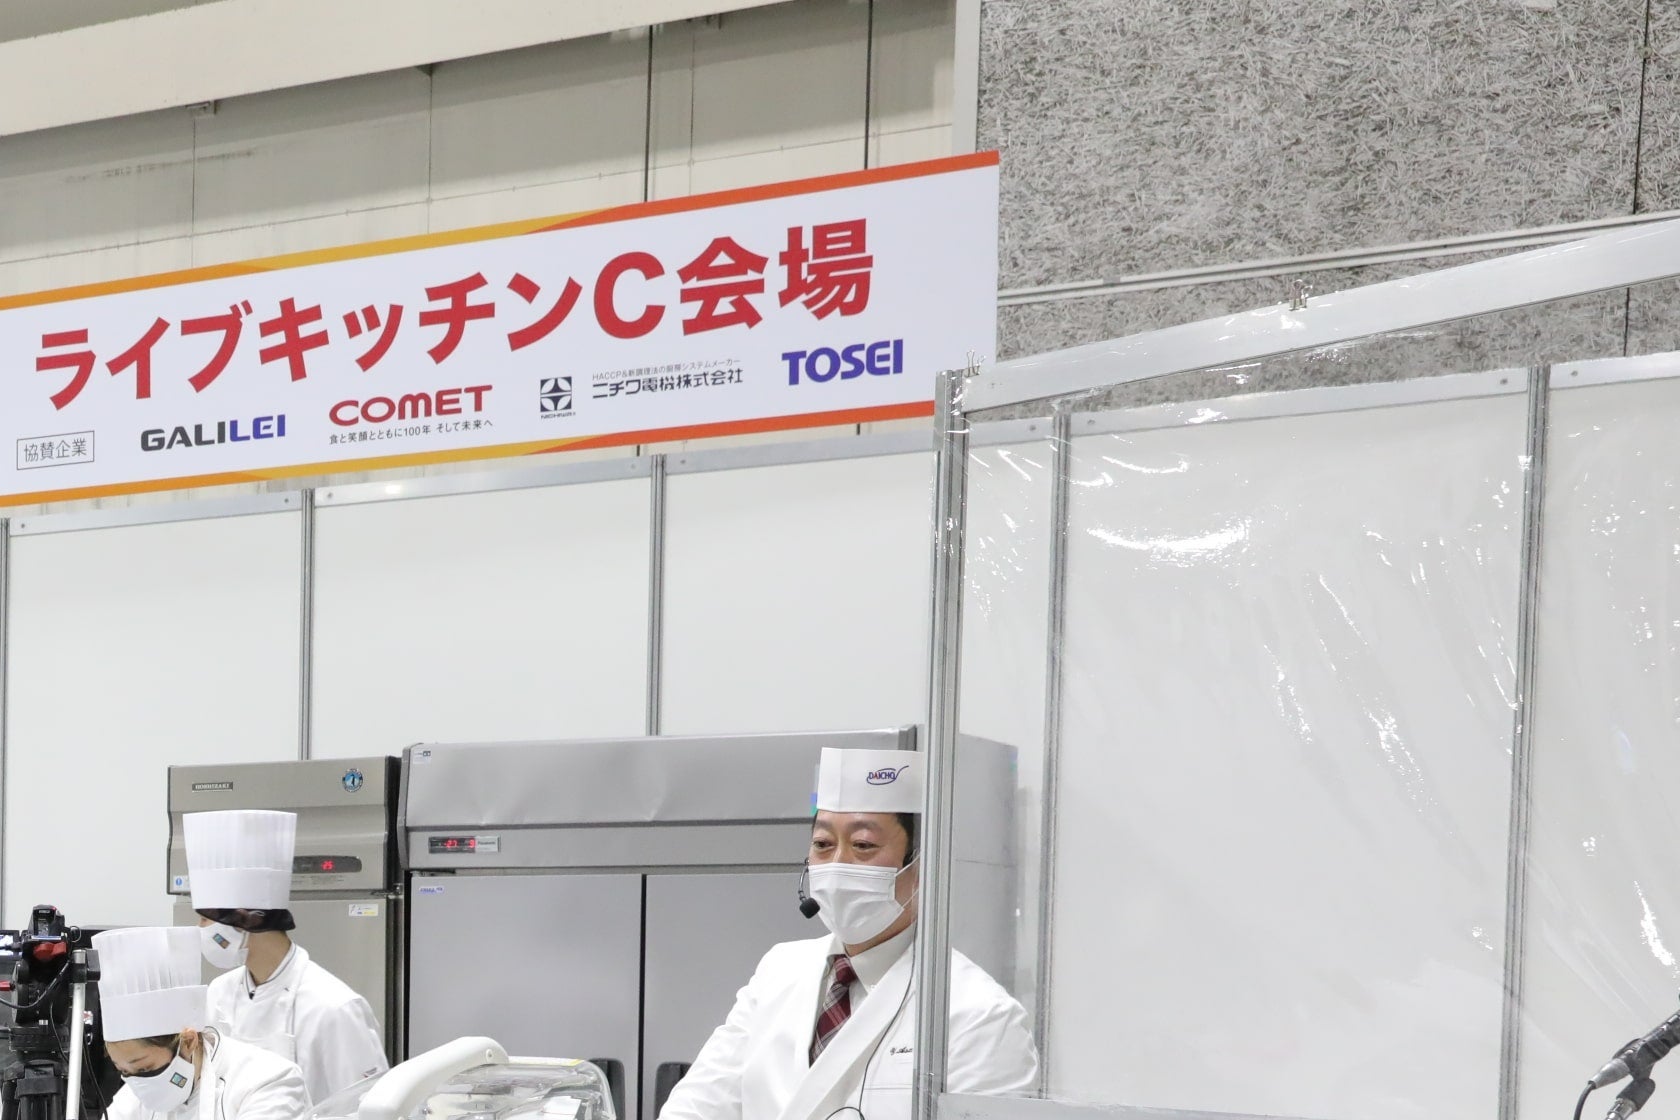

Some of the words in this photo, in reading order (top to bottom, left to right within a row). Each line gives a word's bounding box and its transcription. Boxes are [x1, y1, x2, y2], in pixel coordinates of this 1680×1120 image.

[36, 218, 874, 410] ライブキッチンC会場
[781, 338, 904, 386] TOSEI
[591, 368, 744, 399] ニチワ電機株式会社
[328, 384, 493, 427] COMET
[24, 438, 87, 463] 協賛企業
[140, 414, 286, 452] GALILEI
[329, 425, 432, 445] 食と笑顔とともに100年
[436, 419, 493, 434] そして未来へ
